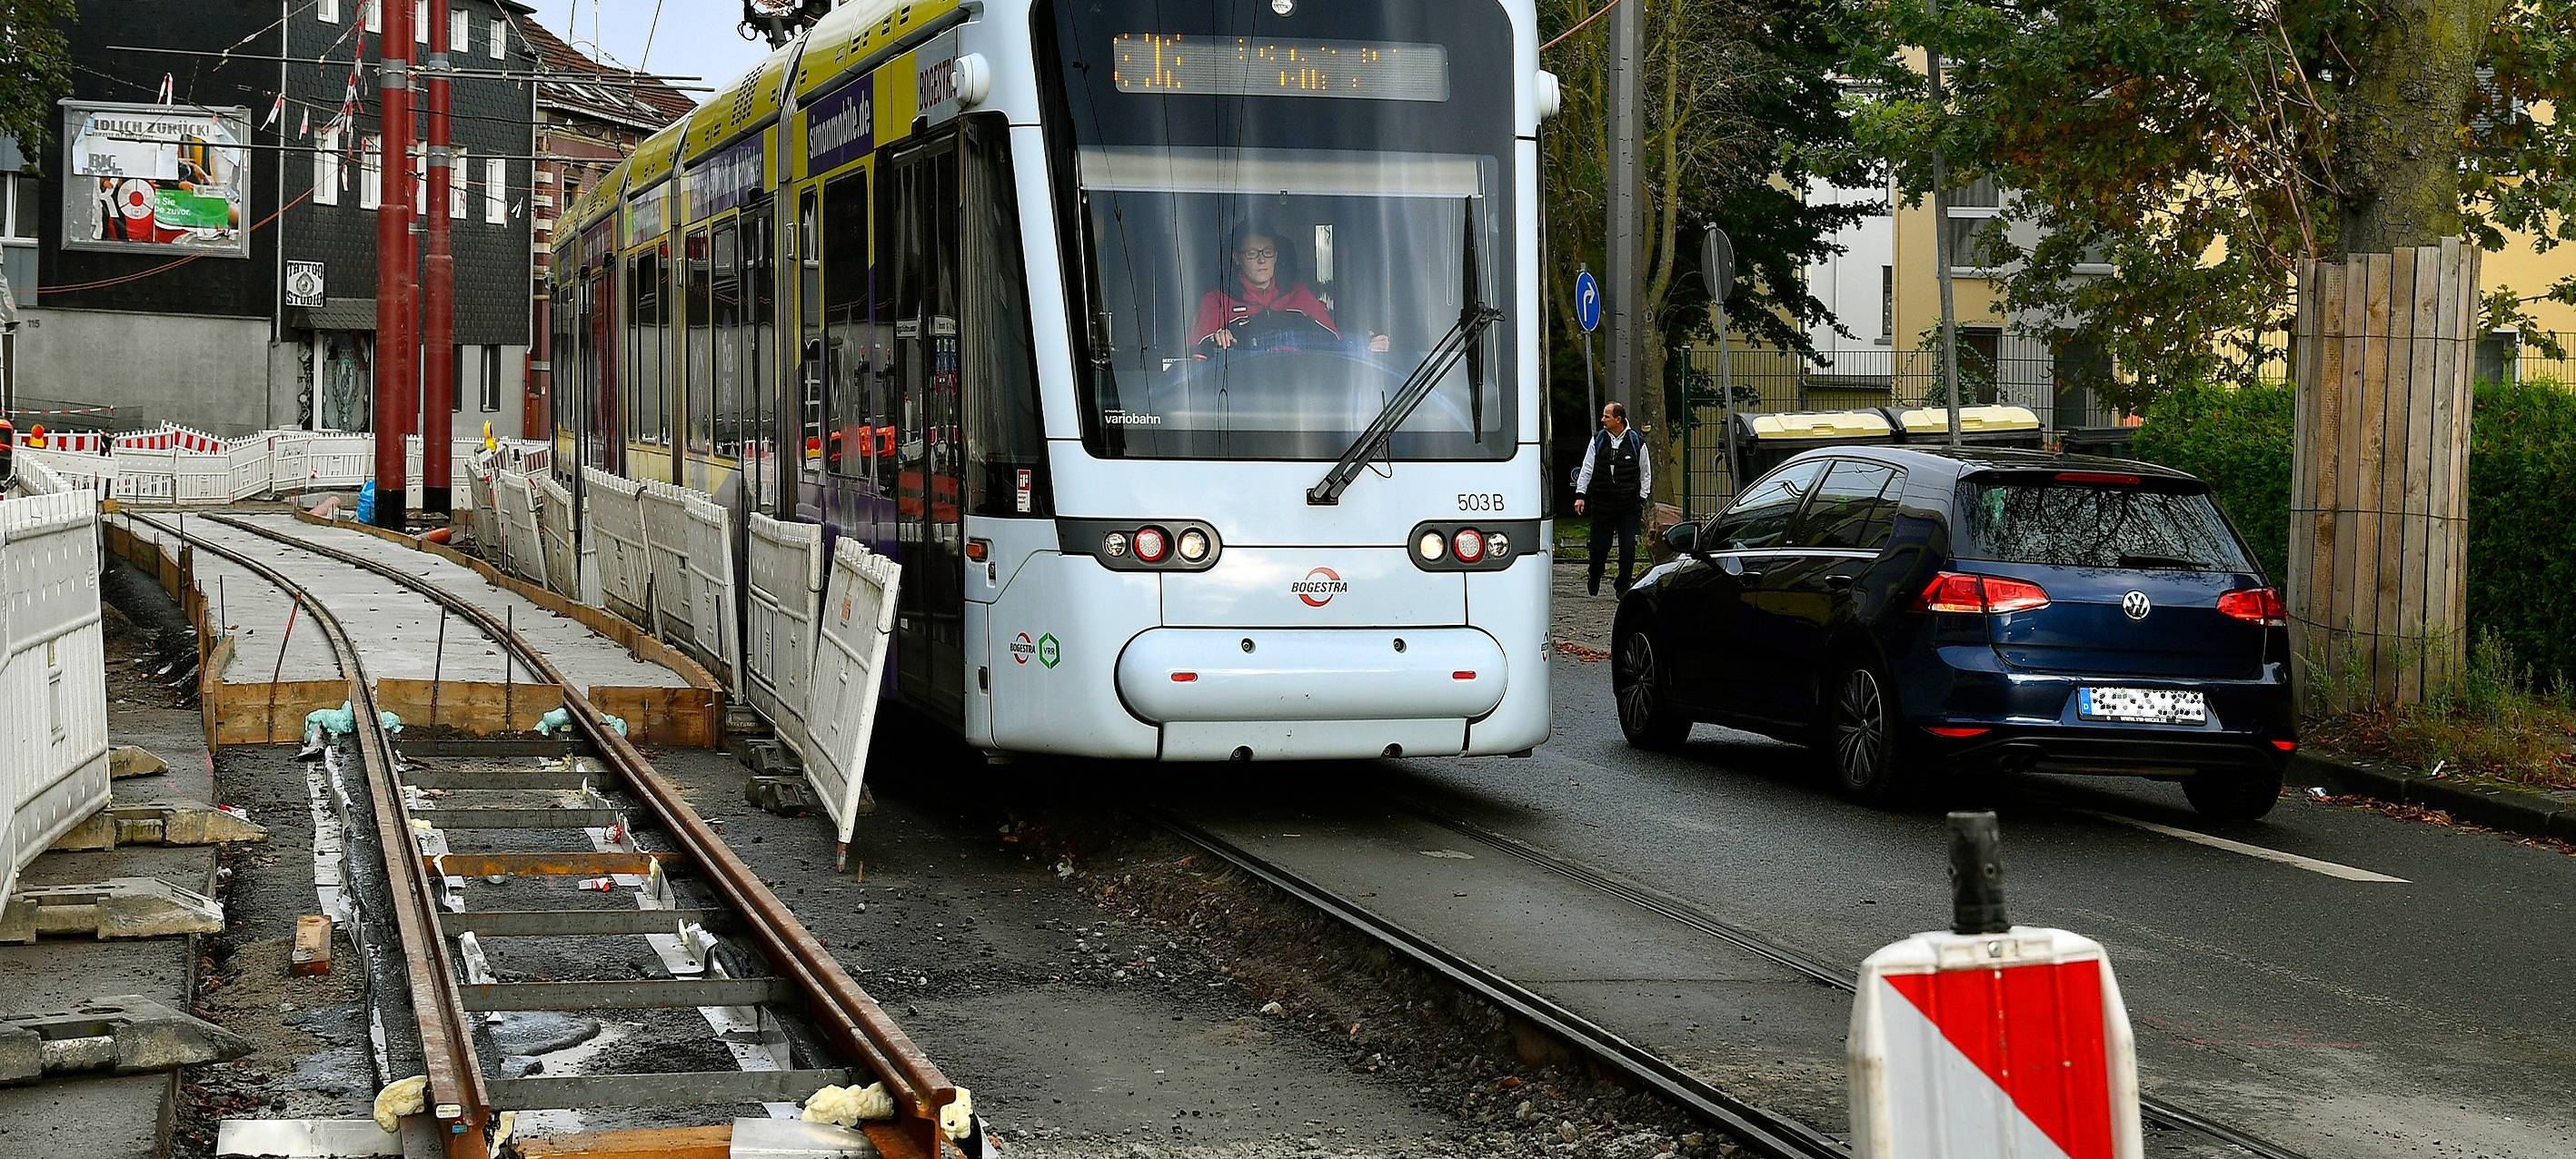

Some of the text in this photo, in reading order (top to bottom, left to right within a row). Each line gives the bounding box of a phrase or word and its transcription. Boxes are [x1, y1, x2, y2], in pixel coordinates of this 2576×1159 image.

[146, 120, 210, 137] ZURÜCK!
[809, 90, 870, 159] simonmobile.de
[166, 206, 191, 216] zuvor.
[287, 263, 323, 280] TATTOO
[287, 291, 323, 305] STUDIO
[1104, 412, 1161, 424] variobahn
[1290, 581, 1348, 593] BOGESTRA
[1010, 642, 1037, 654] BOGESTRA
[1043, 647, 1056, 655] VRR
